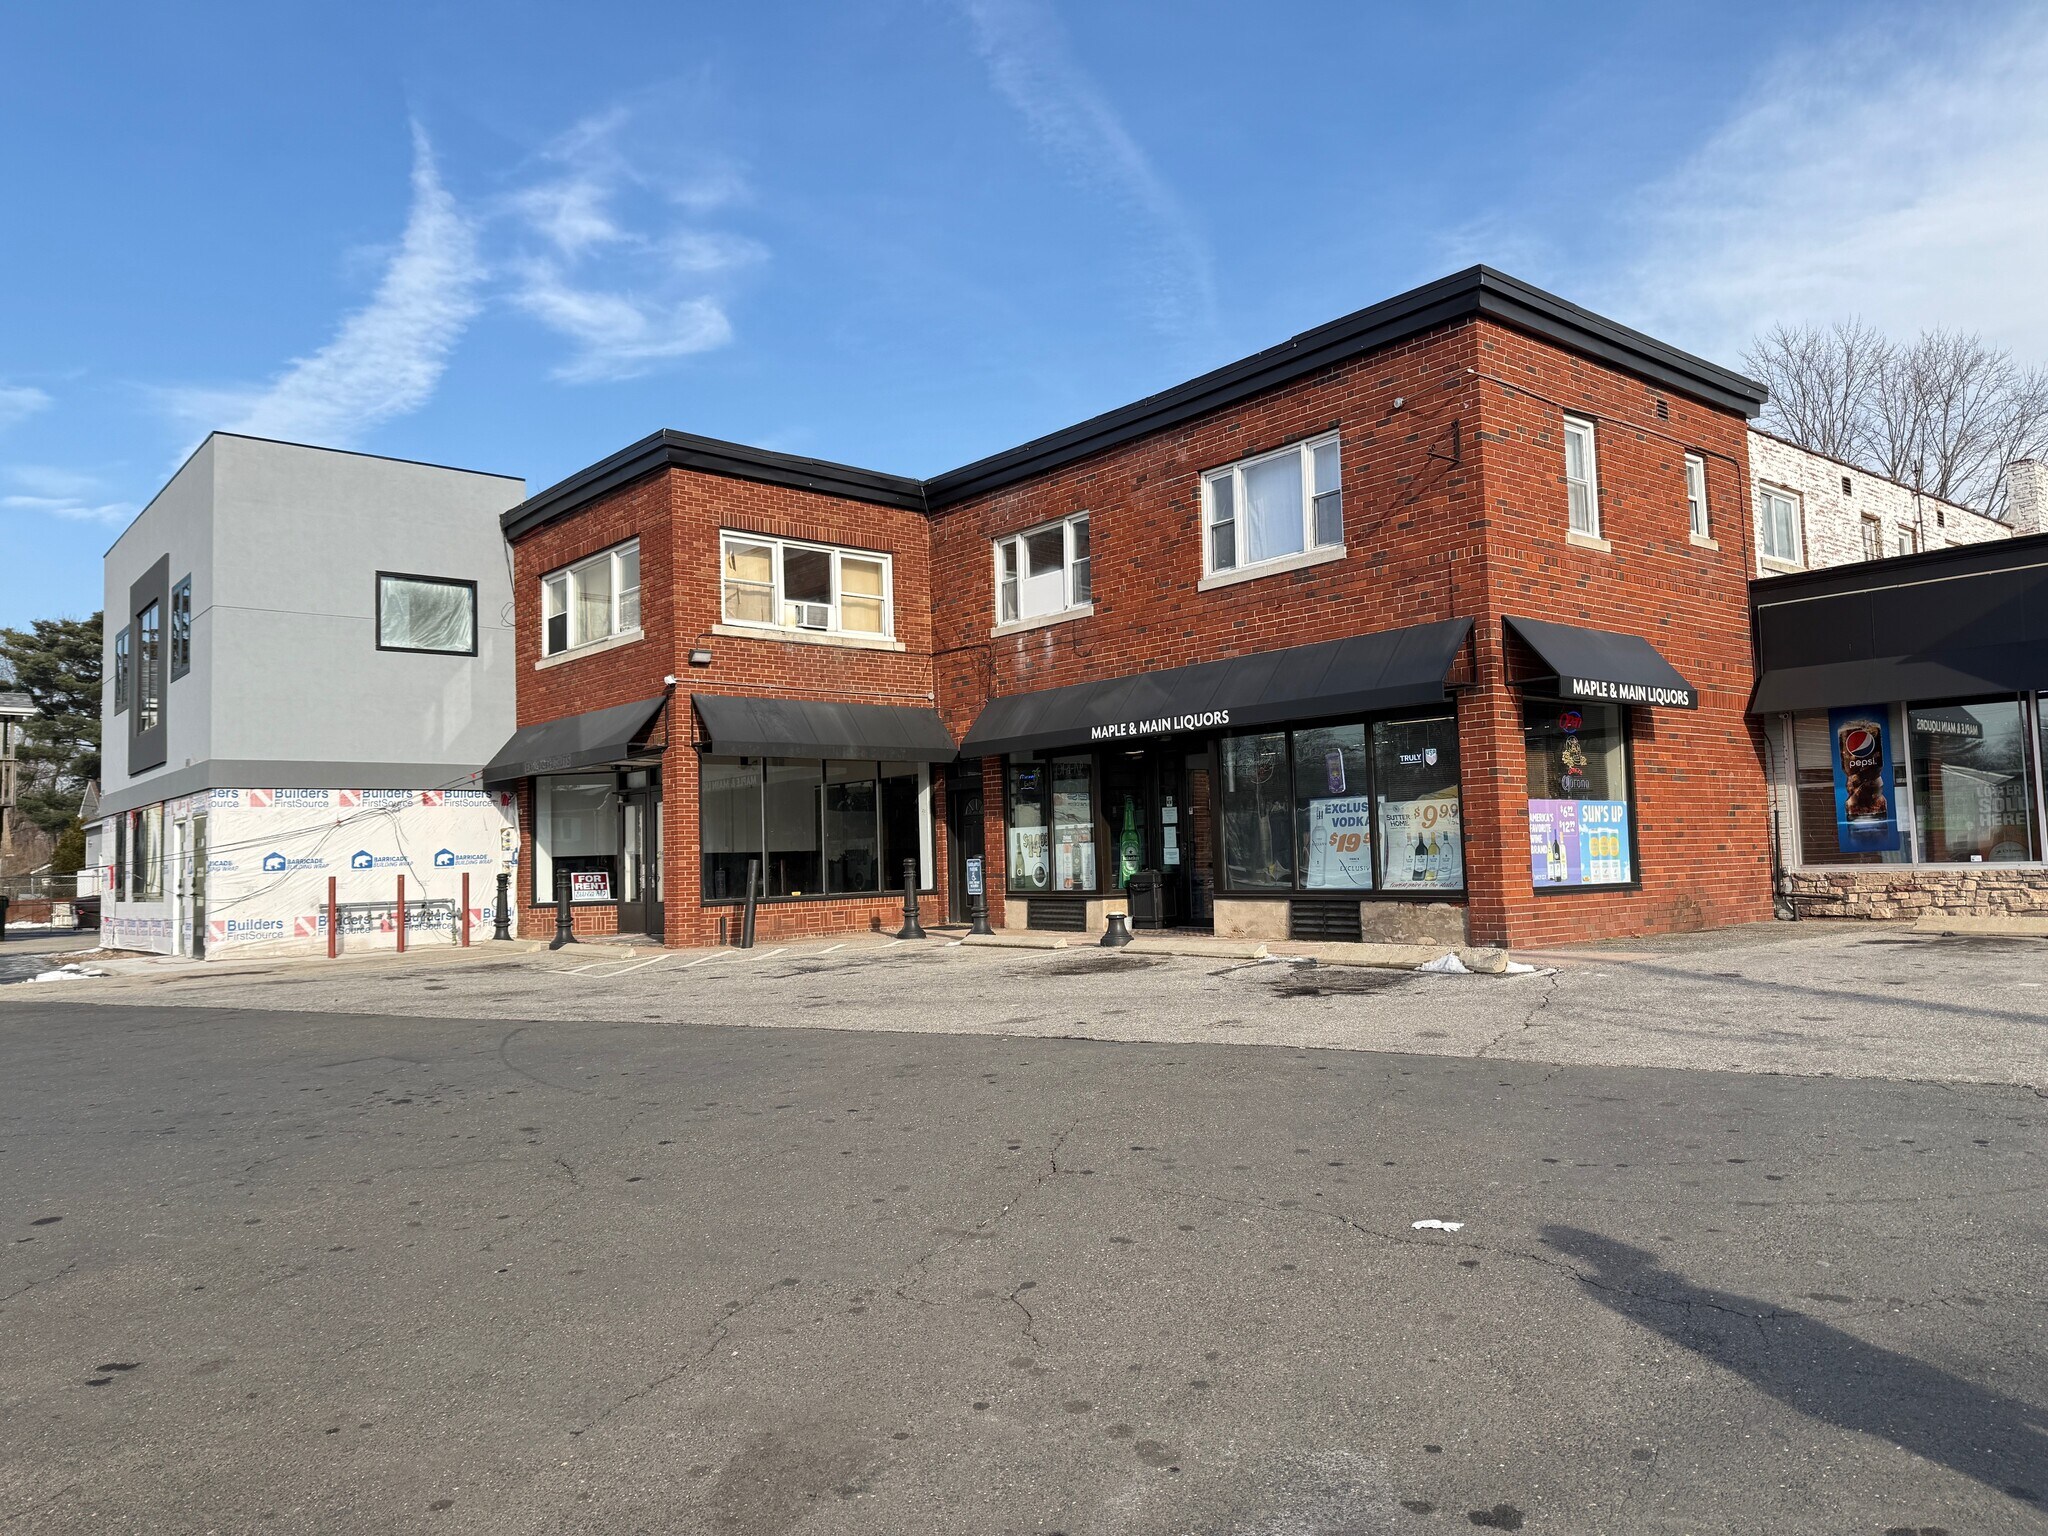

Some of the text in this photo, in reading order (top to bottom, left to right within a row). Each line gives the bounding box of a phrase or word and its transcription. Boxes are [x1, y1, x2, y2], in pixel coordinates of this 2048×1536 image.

[1573, 679, 1689, 705] MAPLE & MAIN LIQUORS
[1091, 710, 1229, 739] MAPLE & MAIN LIQUORS
[1400, 754, 1421, 762] TRULY
[1849, 758, 1875, 769] pepsi
[275, 789, 329, 798] Builders
[362, 790, 413, 798] Builders
[444, 790, 492, 798] Builders
[275, 799, 329, 808] FirstSource
[362, 799, 413, 807] FirstSource
[444, 799, 493, 807] FirstSource
[1582, 804, 1623, 823] SUN'S UP
[1980, 812, 2027, 826] HERE
[575, 882, 606, 891] RENT
[227, 919, 284, 931] Builders
[227, 930, 284, 941] FirstSource
